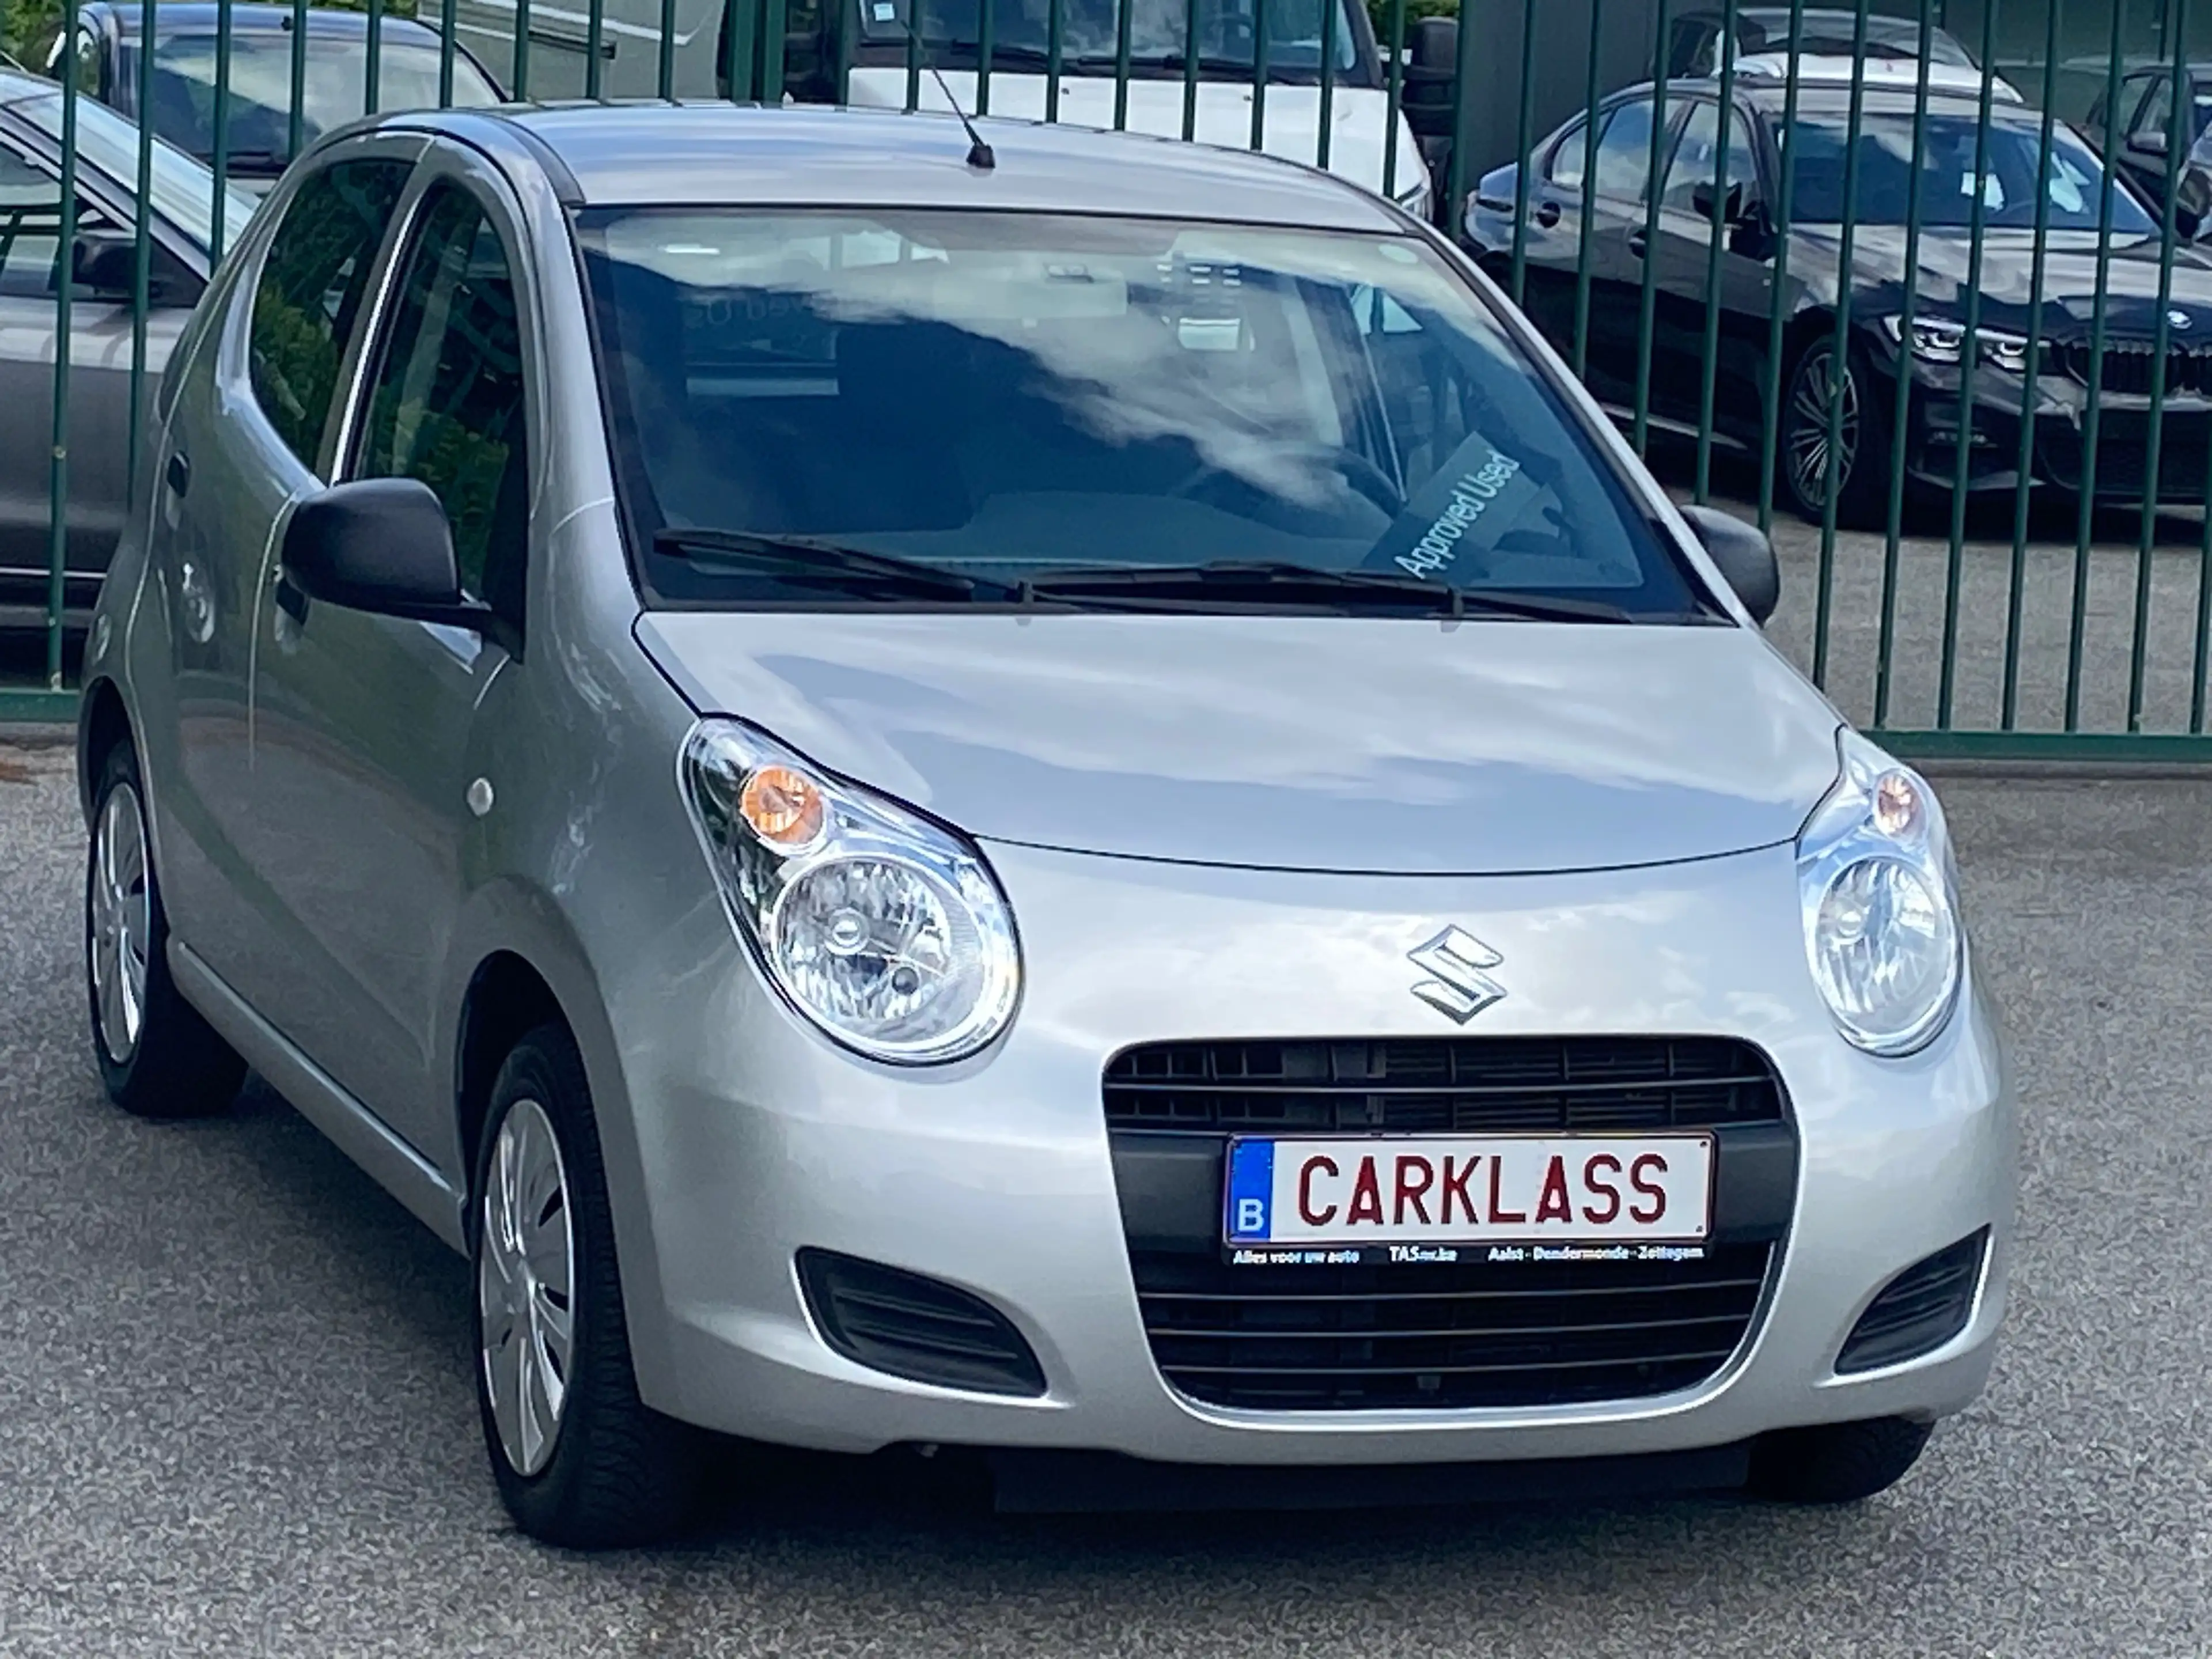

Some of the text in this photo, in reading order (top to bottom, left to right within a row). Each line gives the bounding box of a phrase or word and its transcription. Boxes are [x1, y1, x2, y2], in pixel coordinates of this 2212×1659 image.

[1393, 449, 1521, 579] Approved Used
[1237, 1199, 1264, 1232] B
[1298, 1154, 1668, 1225] CARKLASS
[1233, 1249, 1267, 1264] Alles
[1270, 1251, 1302, 1263] voor
[1327, 1249, 1359, 1264] auto
